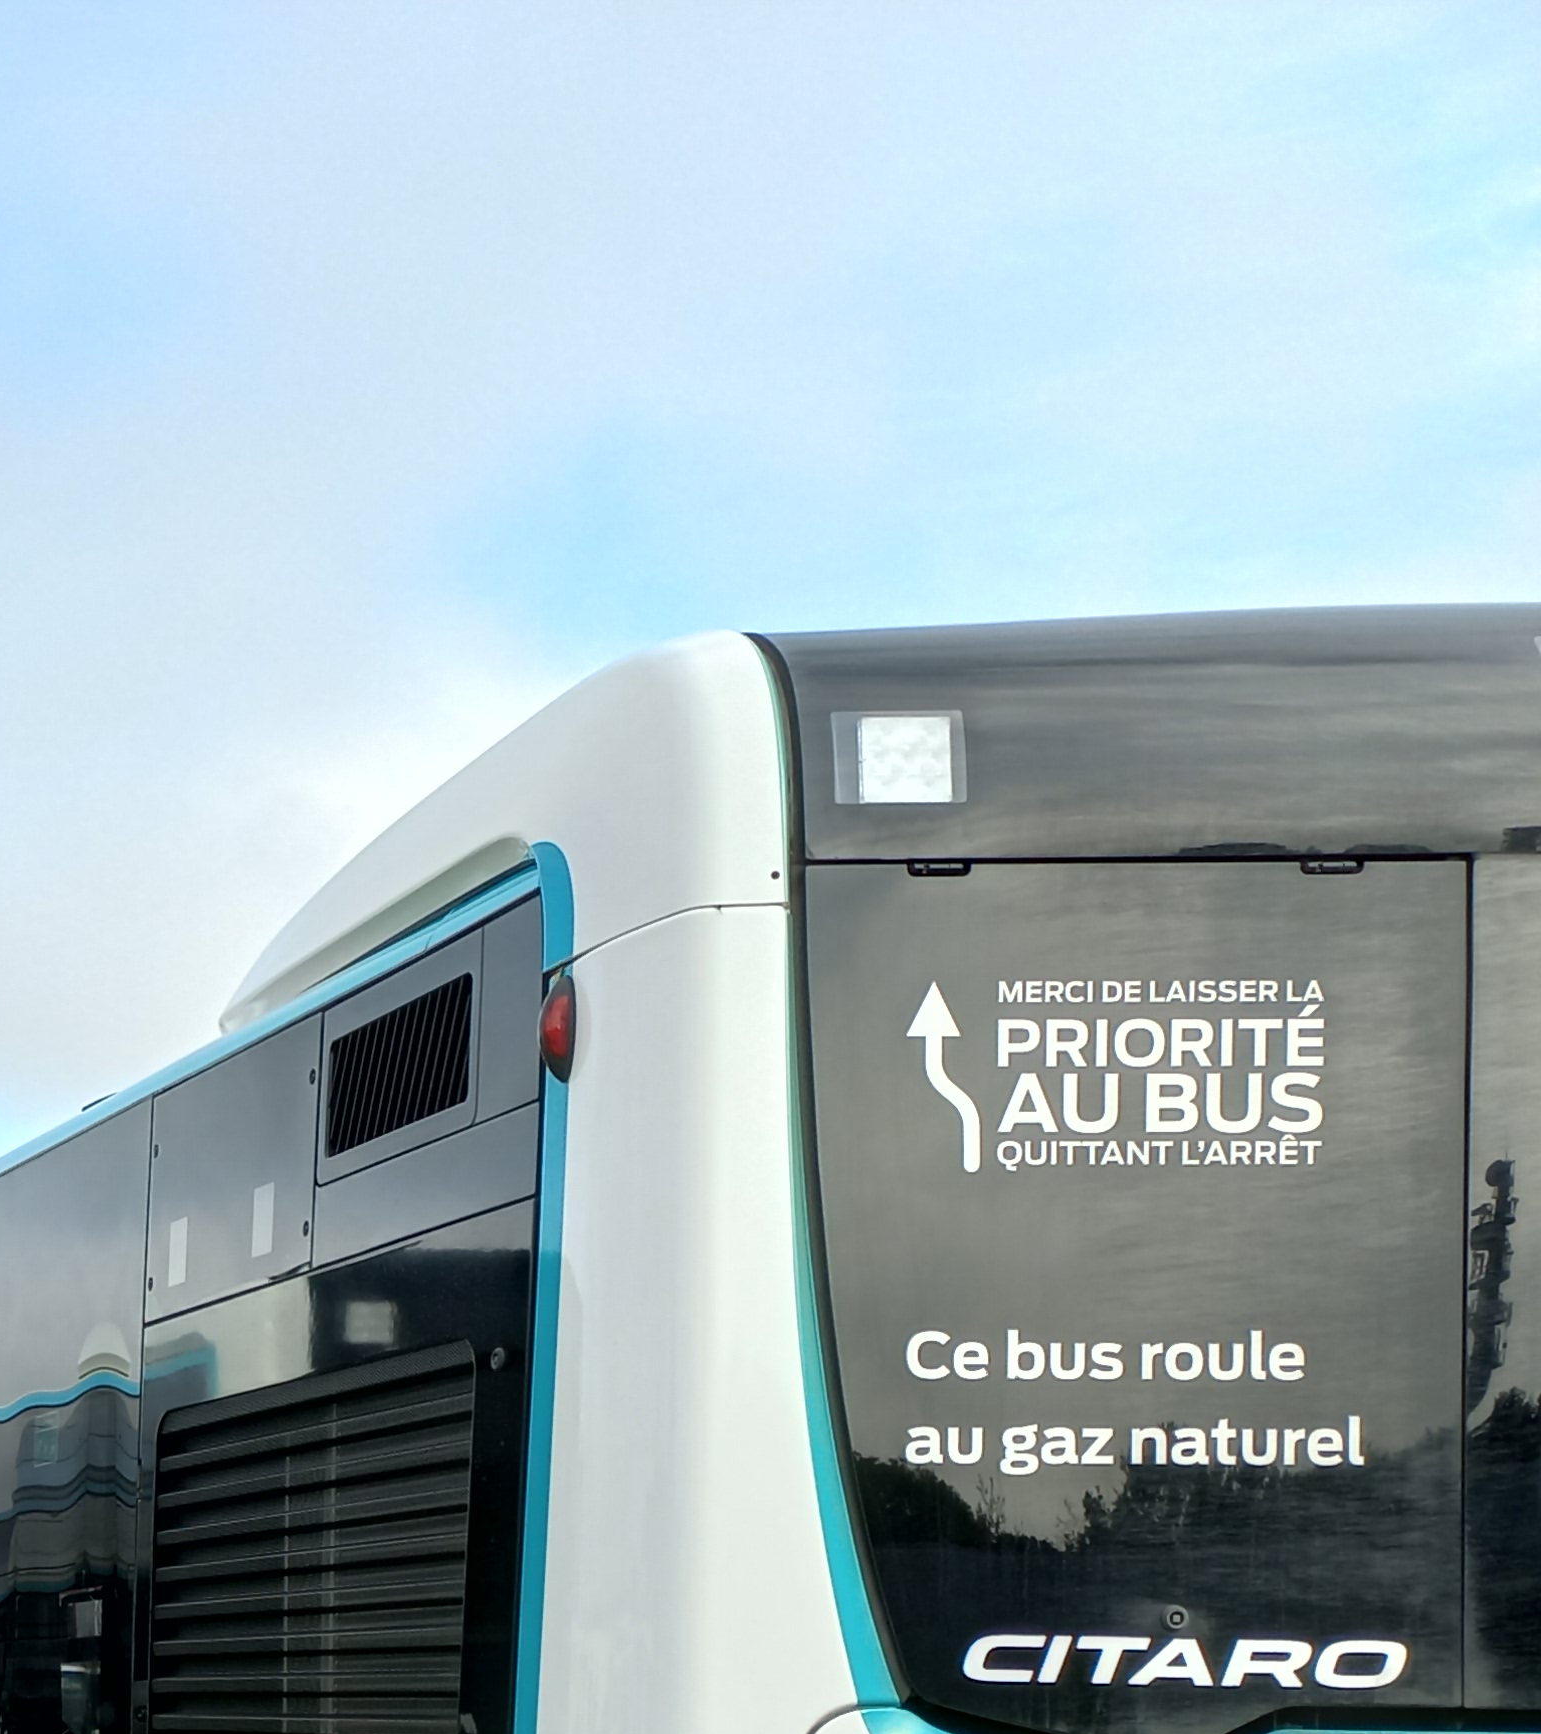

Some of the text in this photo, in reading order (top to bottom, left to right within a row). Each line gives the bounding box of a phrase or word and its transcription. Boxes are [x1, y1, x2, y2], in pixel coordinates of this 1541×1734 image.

[997, 980, 1325, 1003] MERCI DE LAISSER LA
[996, 1004, 1326, 1068] PRIORITÉ
[997, 1072, 1325, 1134] AU BUS
[996, 1134, 1323, 1172] QUITTANT L'ARRÊT
[905, 1329, 1306, 1382] Ce bus roule
[904, 1415, 1365, 1477] au gaz naturel
[962, 1634, 1409, 1690] CITARO
